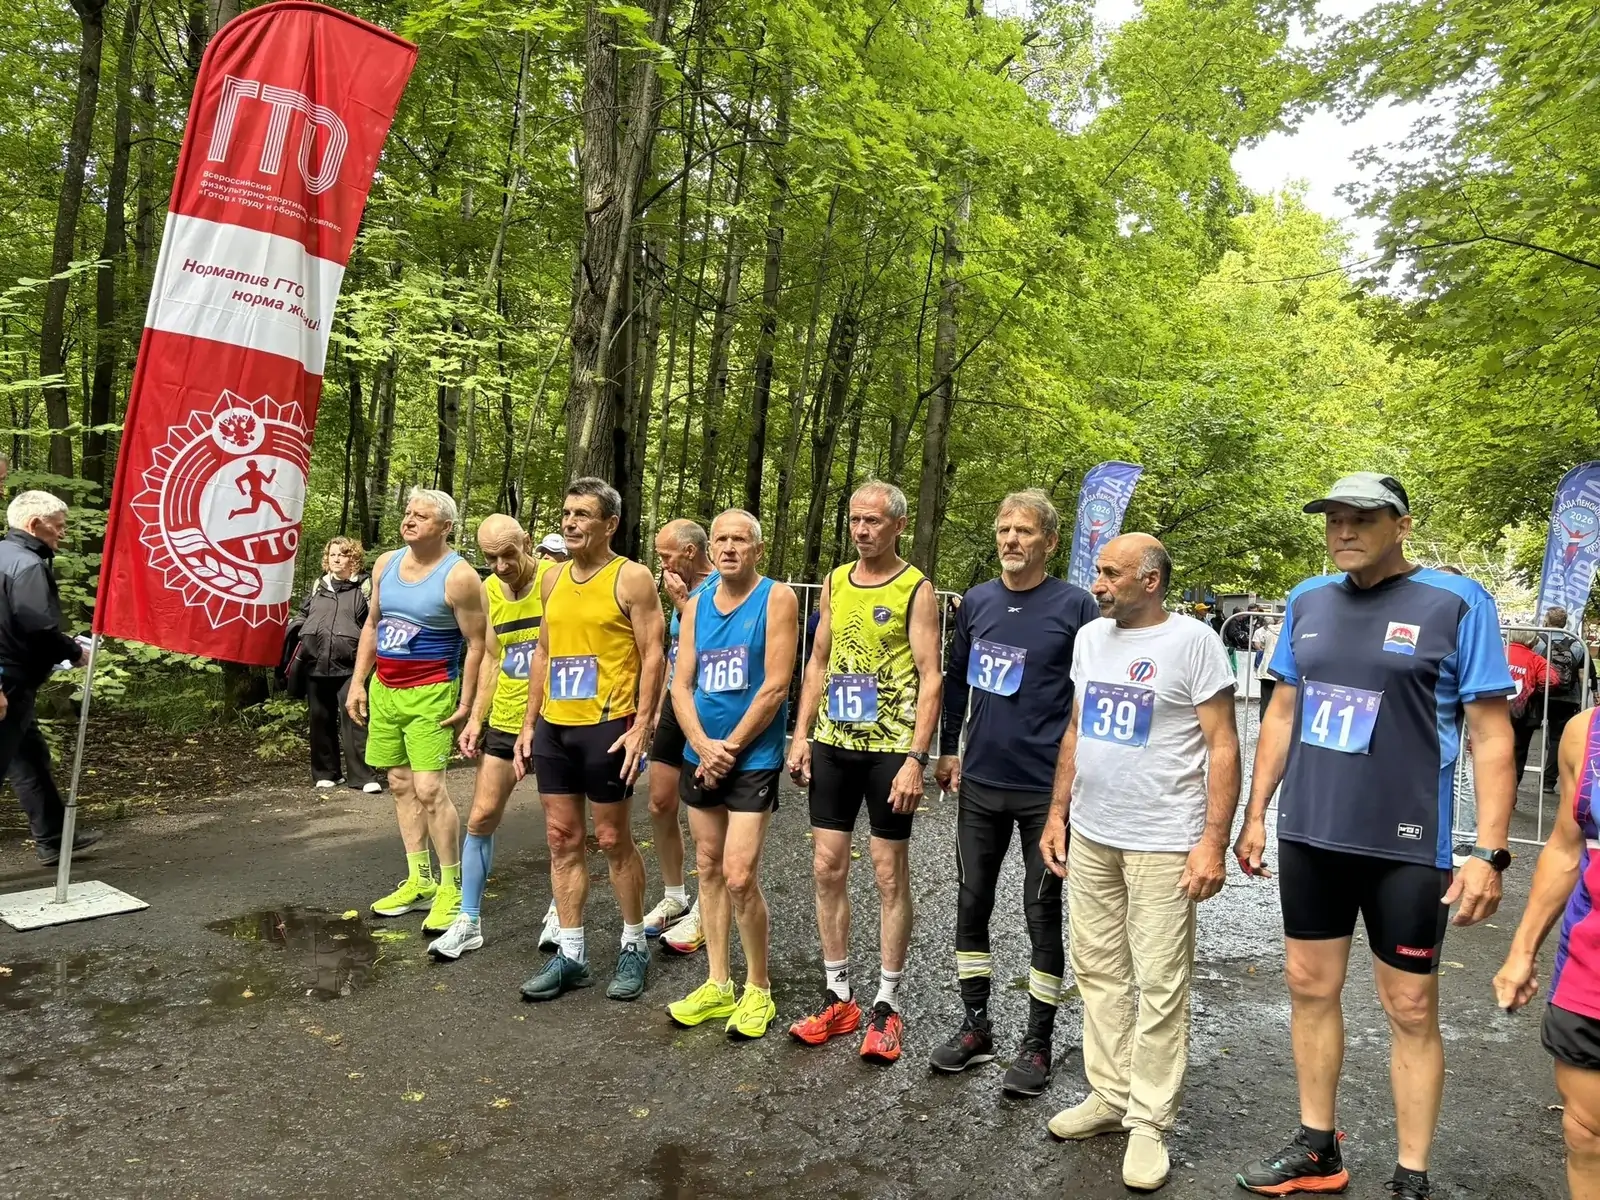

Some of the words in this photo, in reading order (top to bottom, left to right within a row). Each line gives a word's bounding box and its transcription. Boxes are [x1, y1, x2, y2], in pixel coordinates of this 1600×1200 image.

[207, 74, 348, 195] ГТО
[203, 170, 272, 192] Всероссийский
[200, 180, 308, 218] физкультурно-спортив
[238, 197, 264, 210] труду
[273, 205, 307, 224] оборон
[182, 258, 270, 287] Норматив
[232, 290, 285, 310] норма
[1091, 503, 1111, 515] 2026
[1569, 511, 1594, 525] 2026
[243, 528, 299, 561] ГТО
[557, 667, 584, 697] 17
[704, 657, 744, 691] 166
[978, 654, 1012, 691] 37
[835, 686, 862, 719] 15
[1093, 697, 1137, 740] 39
[1311, 700, 1355, 747] 41
